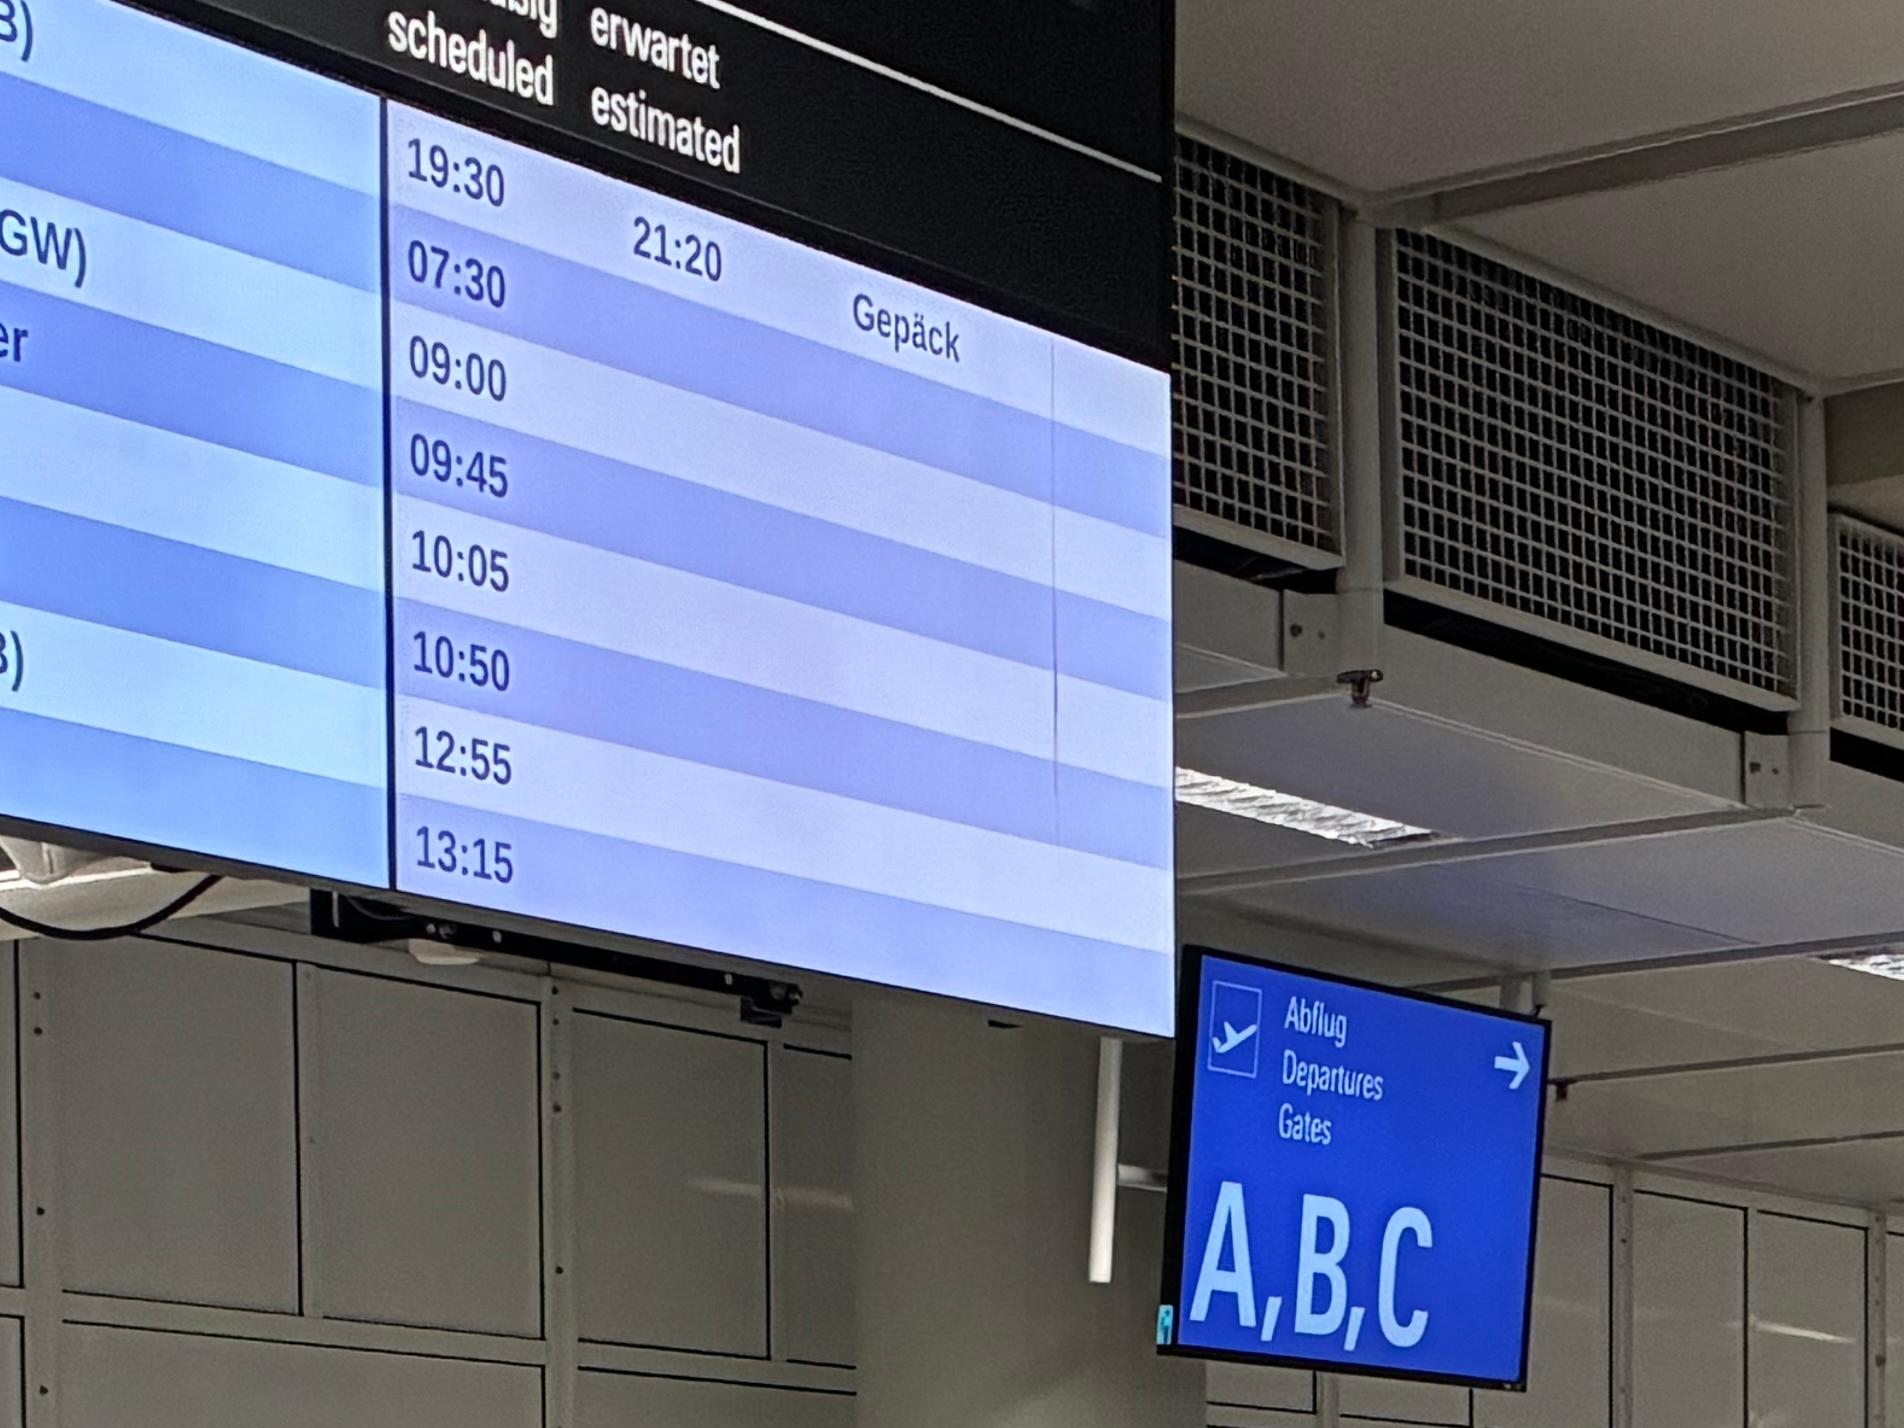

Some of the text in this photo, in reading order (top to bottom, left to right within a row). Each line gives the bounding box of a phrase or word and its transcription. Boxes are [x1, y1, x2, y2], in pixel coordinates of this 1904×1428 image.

[387, 10, 555, 106] scheduled
[590, 7, 721, 90] erwartet
[591, 85, 741, 175] estimated
[406, 138, 962, 364] 19:30 21:20 Gepäck
[406, 240, 507, 311] 07:30
[407, 335, 508, 404] 09:00
[407, 433, 509, 500] 09:45
[409, 529, 510, 593] 10:05
[411, 630, 511, 693] 10:50
[412, 724, 513, 787] 12:55
[414, 825, 515, 885] 13:15
[1284, 995, 1348, 1049] Abflug
[1281, 1048, 1384, 1101] Departures
[1278, 1103, 1332, 1146] Gates
[1188, 1180, 1434, 1352] A,B,C
